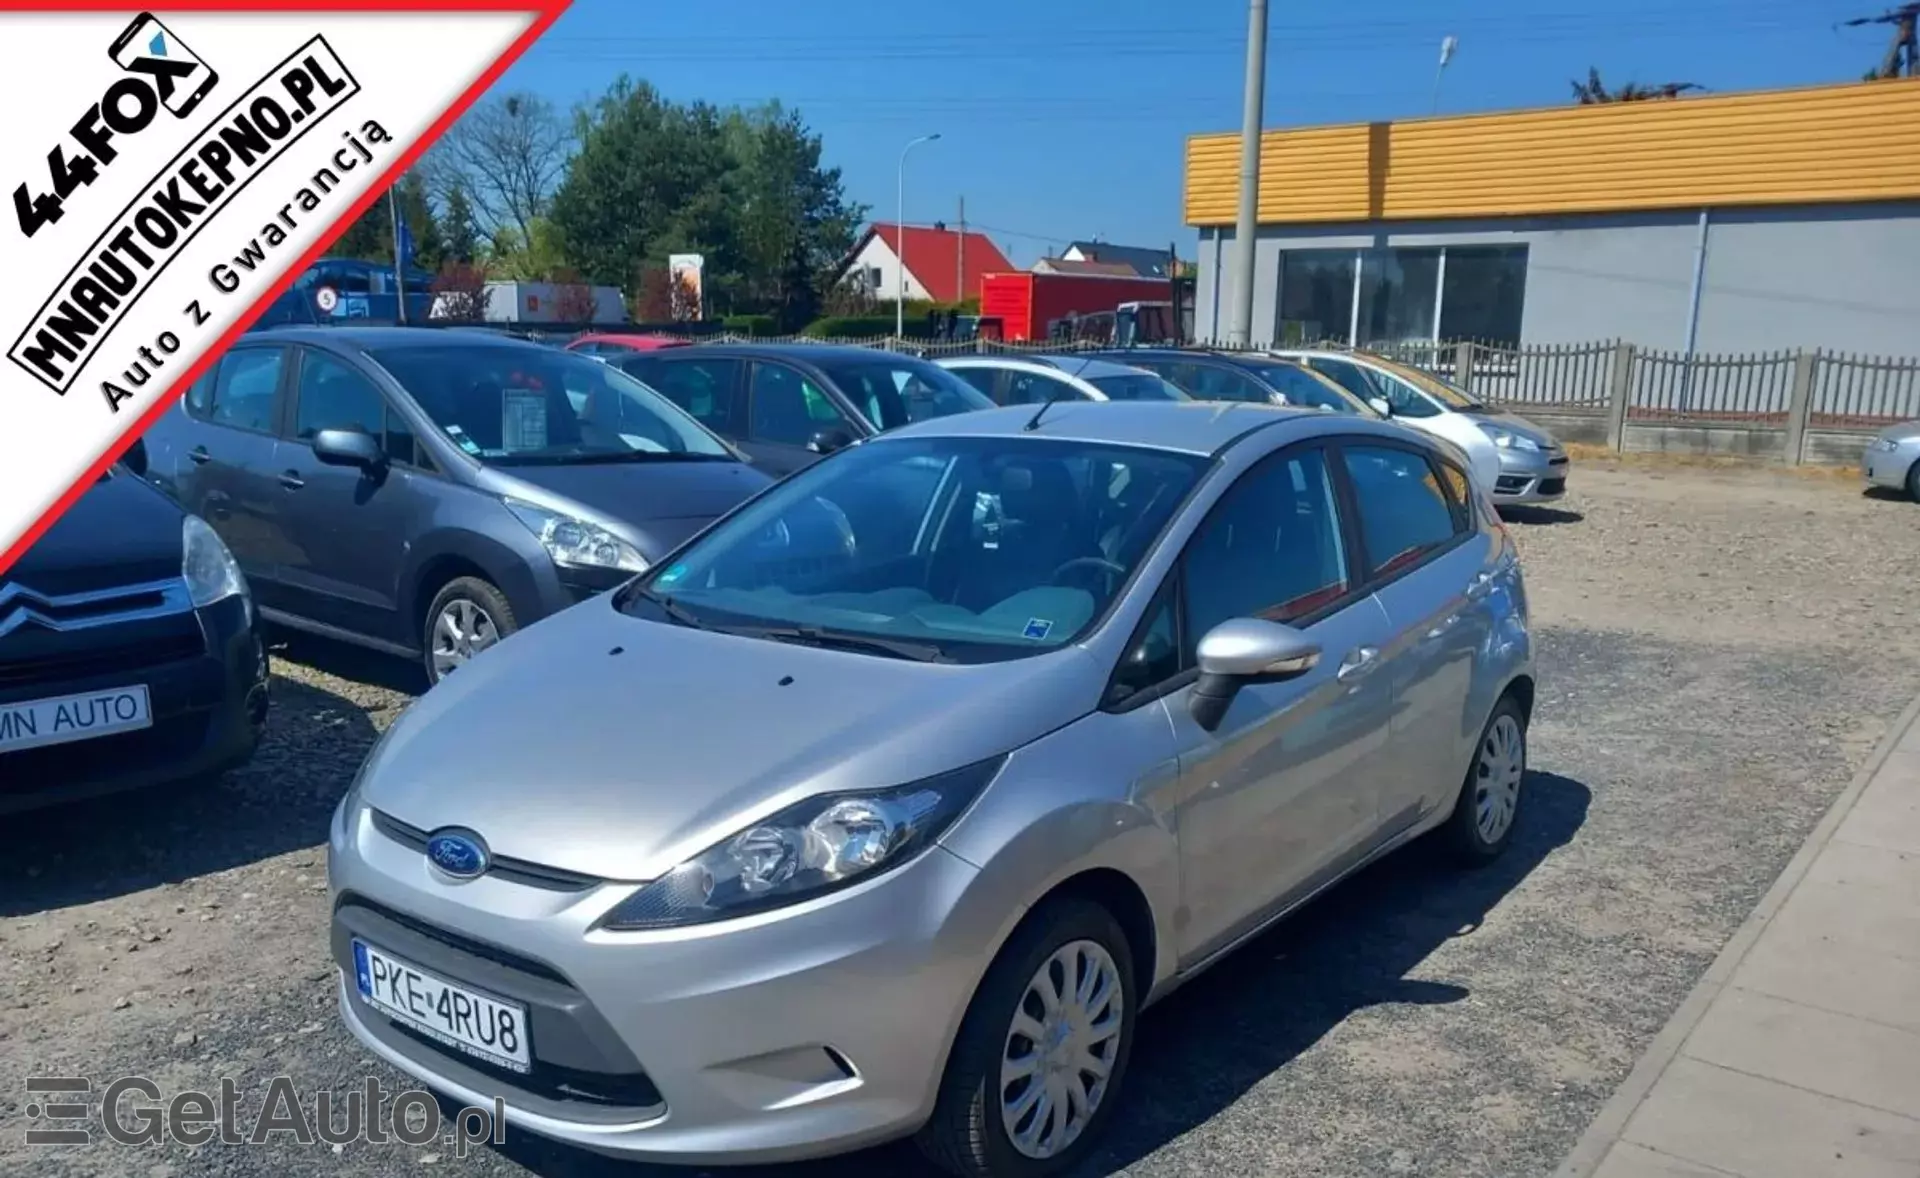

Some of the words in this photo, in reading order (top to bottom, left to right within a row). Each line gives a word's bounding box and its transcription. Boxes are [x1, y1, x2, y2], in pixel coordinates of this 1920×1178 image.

[53, 694, 137, 732] AUTO
[371, 954, 427, 1018] PKE
[436, 987, 518, 1053] 4RU8
